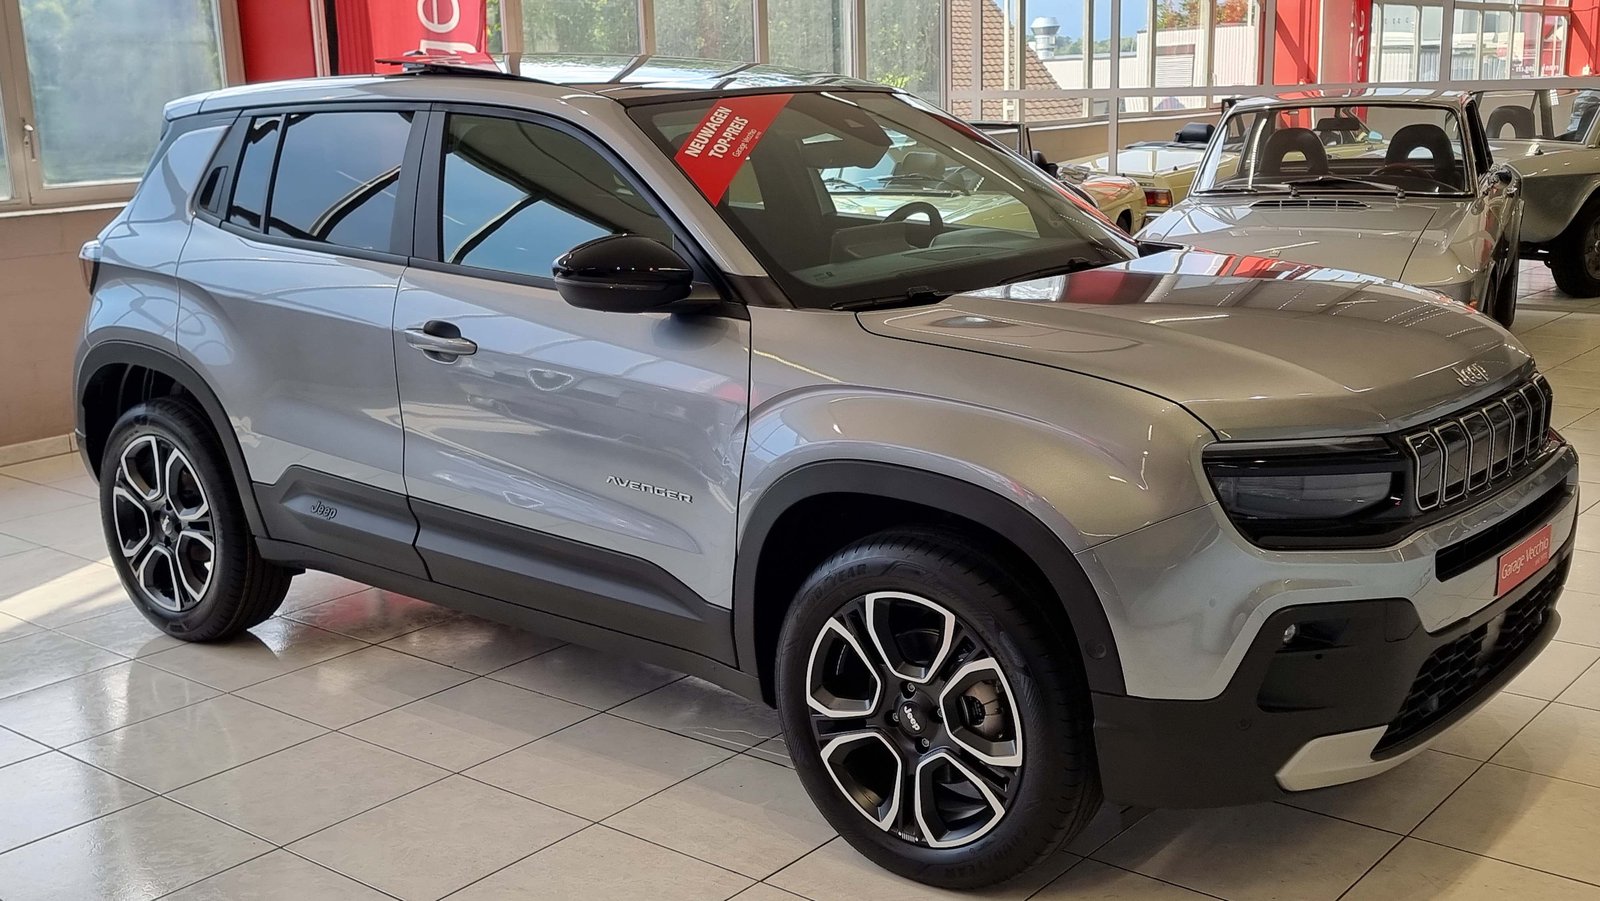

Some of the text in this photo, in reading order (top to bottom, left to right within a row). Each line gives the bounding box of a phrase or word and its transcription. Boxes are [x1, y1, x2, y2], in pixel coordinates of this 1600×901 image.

[684, 106, 733, 158] NEUWAGEN
[708, 116, 749, 159] TOP-PREIS
[1451, 362, 1489, 387] Jeep
[606, 475, 694, 504] AVENGER
[311, 500, 338, 520] Jeep
[1501, 555, 1526, 579] Garage
[1525, 536, 1549, 562] Vecchio
[903, 705, 921, 731] Jeep
